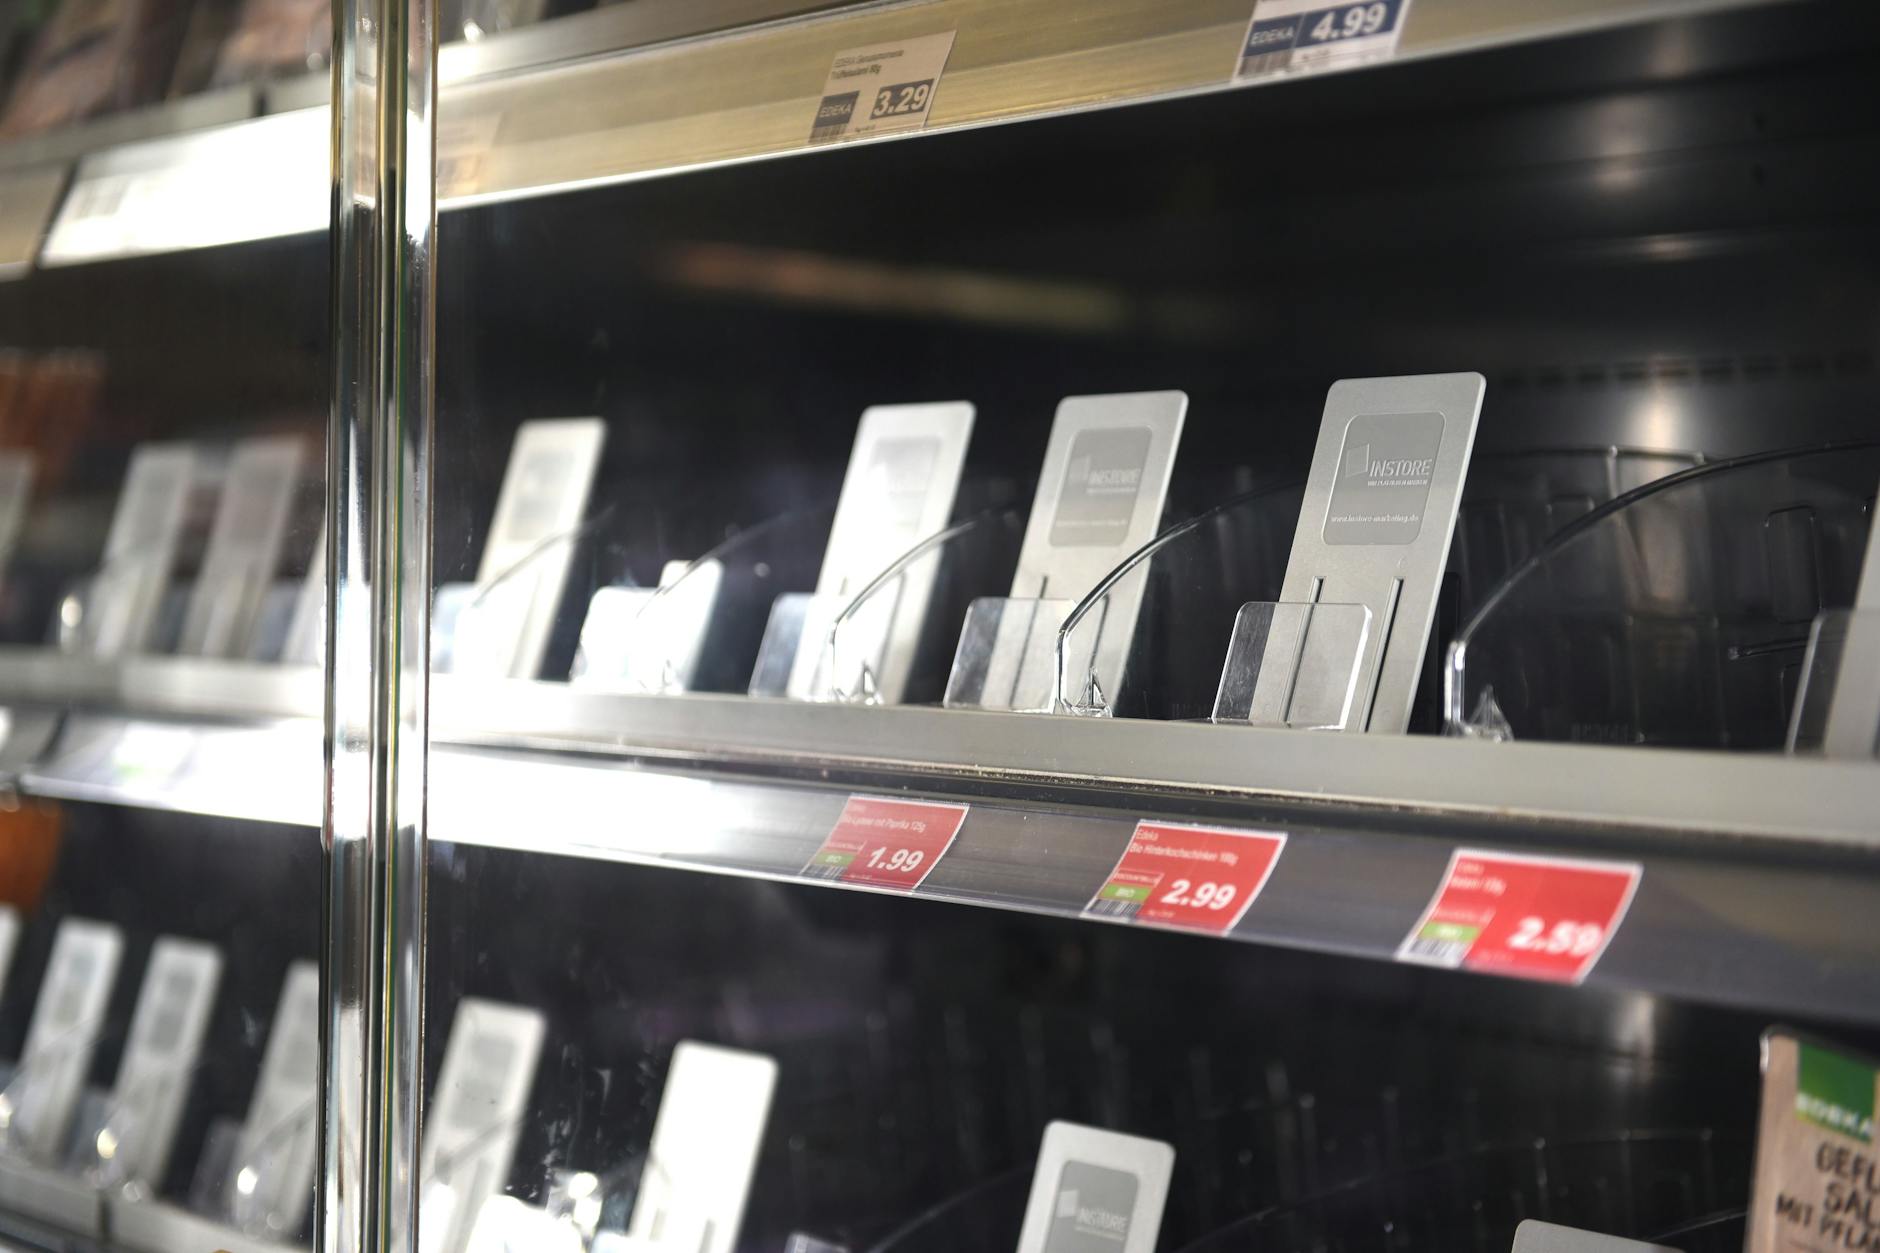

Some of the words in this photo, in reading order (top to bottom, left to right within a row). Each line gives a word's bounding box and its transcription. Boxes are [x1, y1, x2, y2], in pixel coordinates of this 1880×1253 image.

[1250, 26, 1295, 46] EDEKA
[1310, 2, 1387, 41] 4.99
[819, 103, 852, 118] EDEKA
[873, 84, 929, 116] 3.29
[1369, 459, 1432, 477] INSTORE
[867, 847, 924, 872] 1.99
[1161, 879, 1237, 911] 2.99
[1815, 1140, 1880, 1194] GEFL
[1823, 1182, 1880, 1230] SAL
